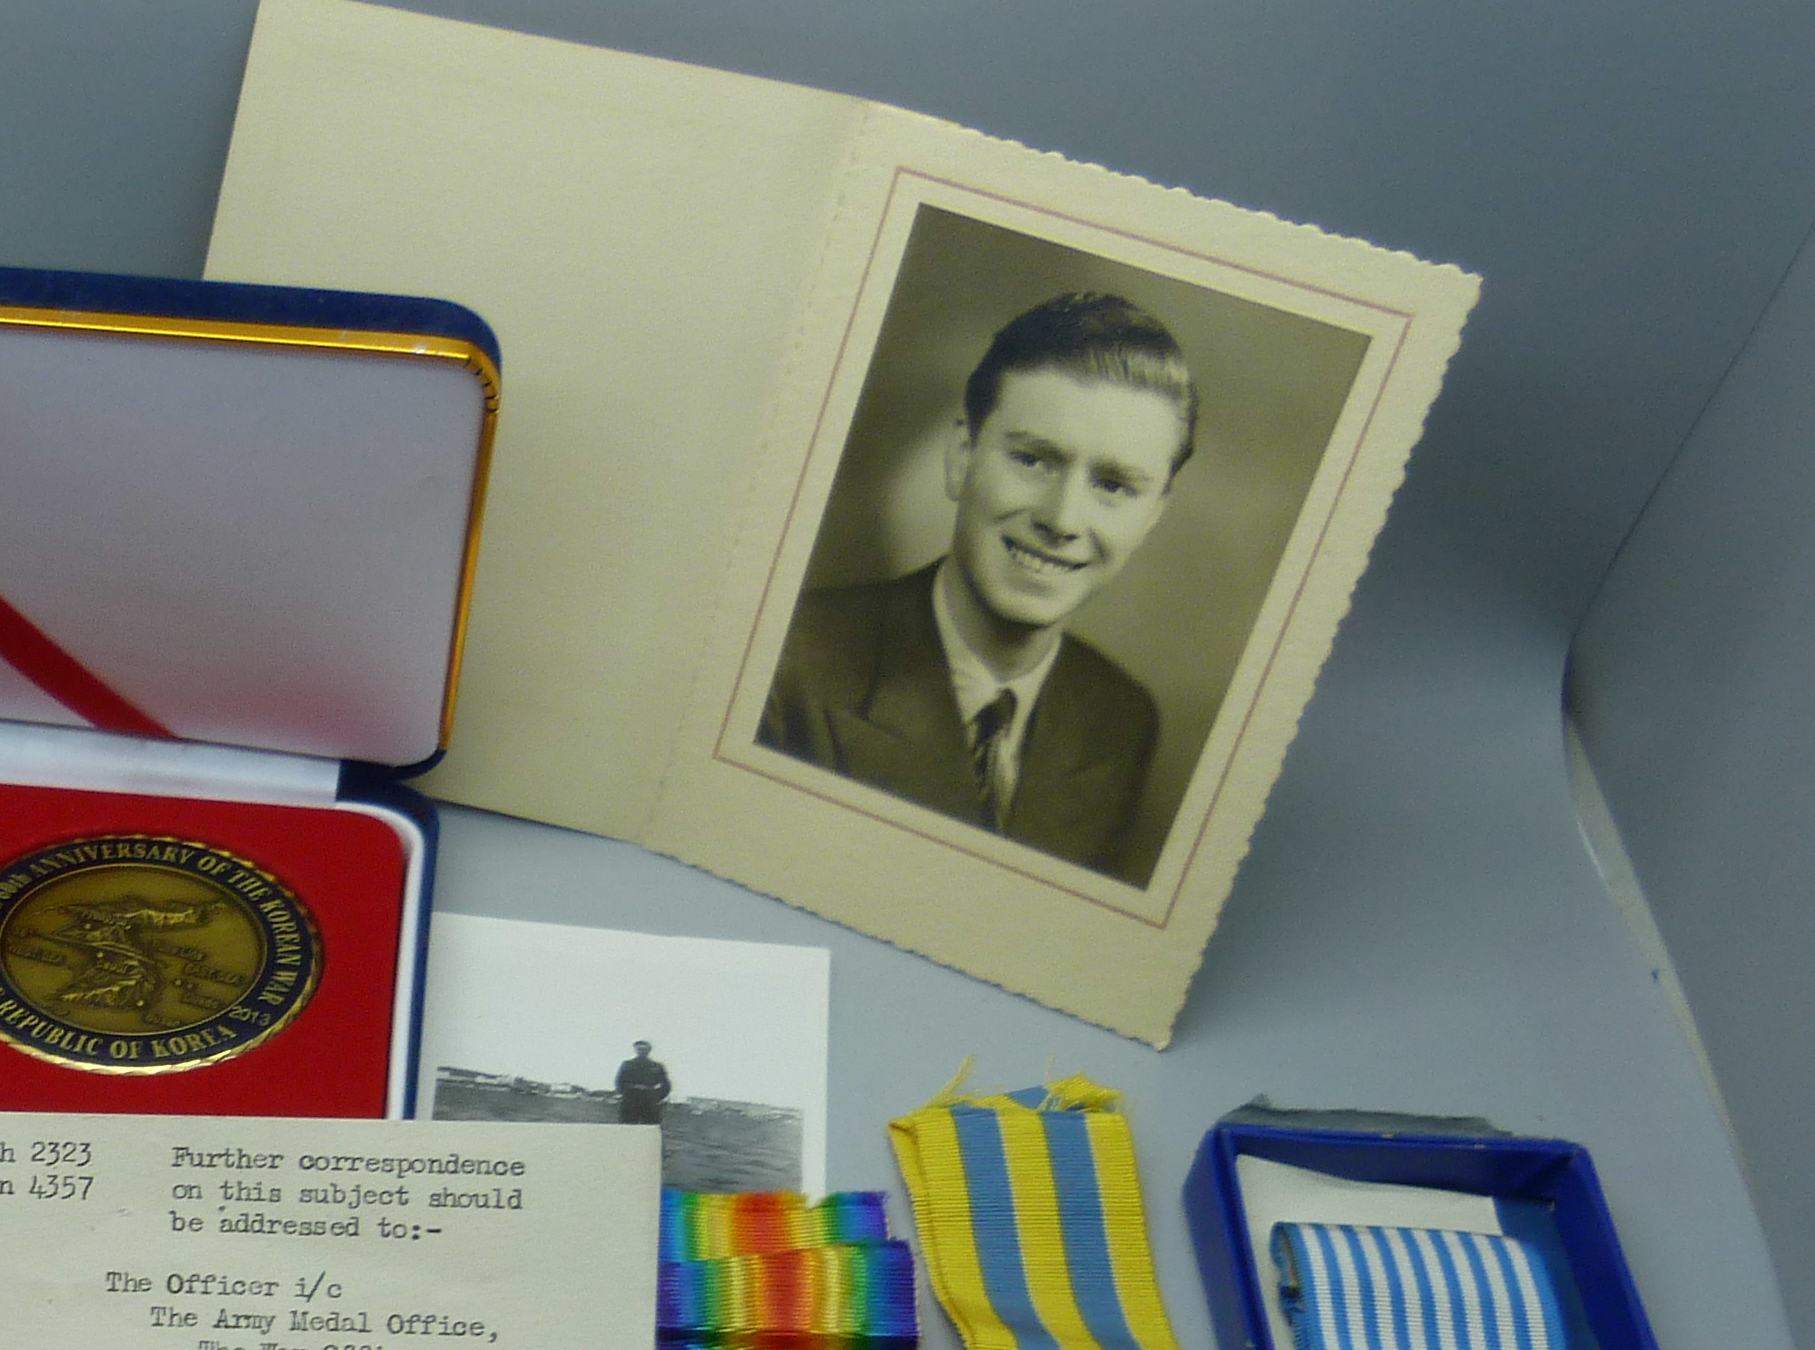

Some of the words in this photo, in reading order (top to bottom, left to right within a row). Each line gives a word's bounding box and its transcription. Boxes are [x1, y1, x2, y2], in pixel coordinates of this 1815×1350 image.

[30, 843, 196, 878] ANNIVERSARY
[197, 855, 232, 876] OF
[227, 869, 273, 901] THE
[259, 899, 302, 966] KOREAN
[258, 971, 298, 1006] WAR
[109, 1039, 142, 1059] OF
[152, 1024, 237, 1058] KOREA
[31, 1141, 92, 1166] 2323
[171, 1147, 284, 1170] Further
[299, 1154, 526, 1178] correspondence
[29, 1175, 93, 1200] 4357
[172, 1184, 202, 1200] on
[220, 1181, 281, 1201] this
[299, 1183, 410, 1208] subject
[428, 1188, 524, 1210] should
[169, 1210, 204, 1232] be
[218, 1212, 360, 1236] addressed
[378, 1217, 442, 1240] to:-
[105, 1272, 152, 1295] The
[167, 1274, 279, 1297] Officer
[293, 1272, 343, 1303] i/c
[150, 1306, 198, 1328] The
[213, 1309, 276, 1335] Army
[289, 1310, 373, 1334] Medal
[386, 1314, 499, 1343] Office,
